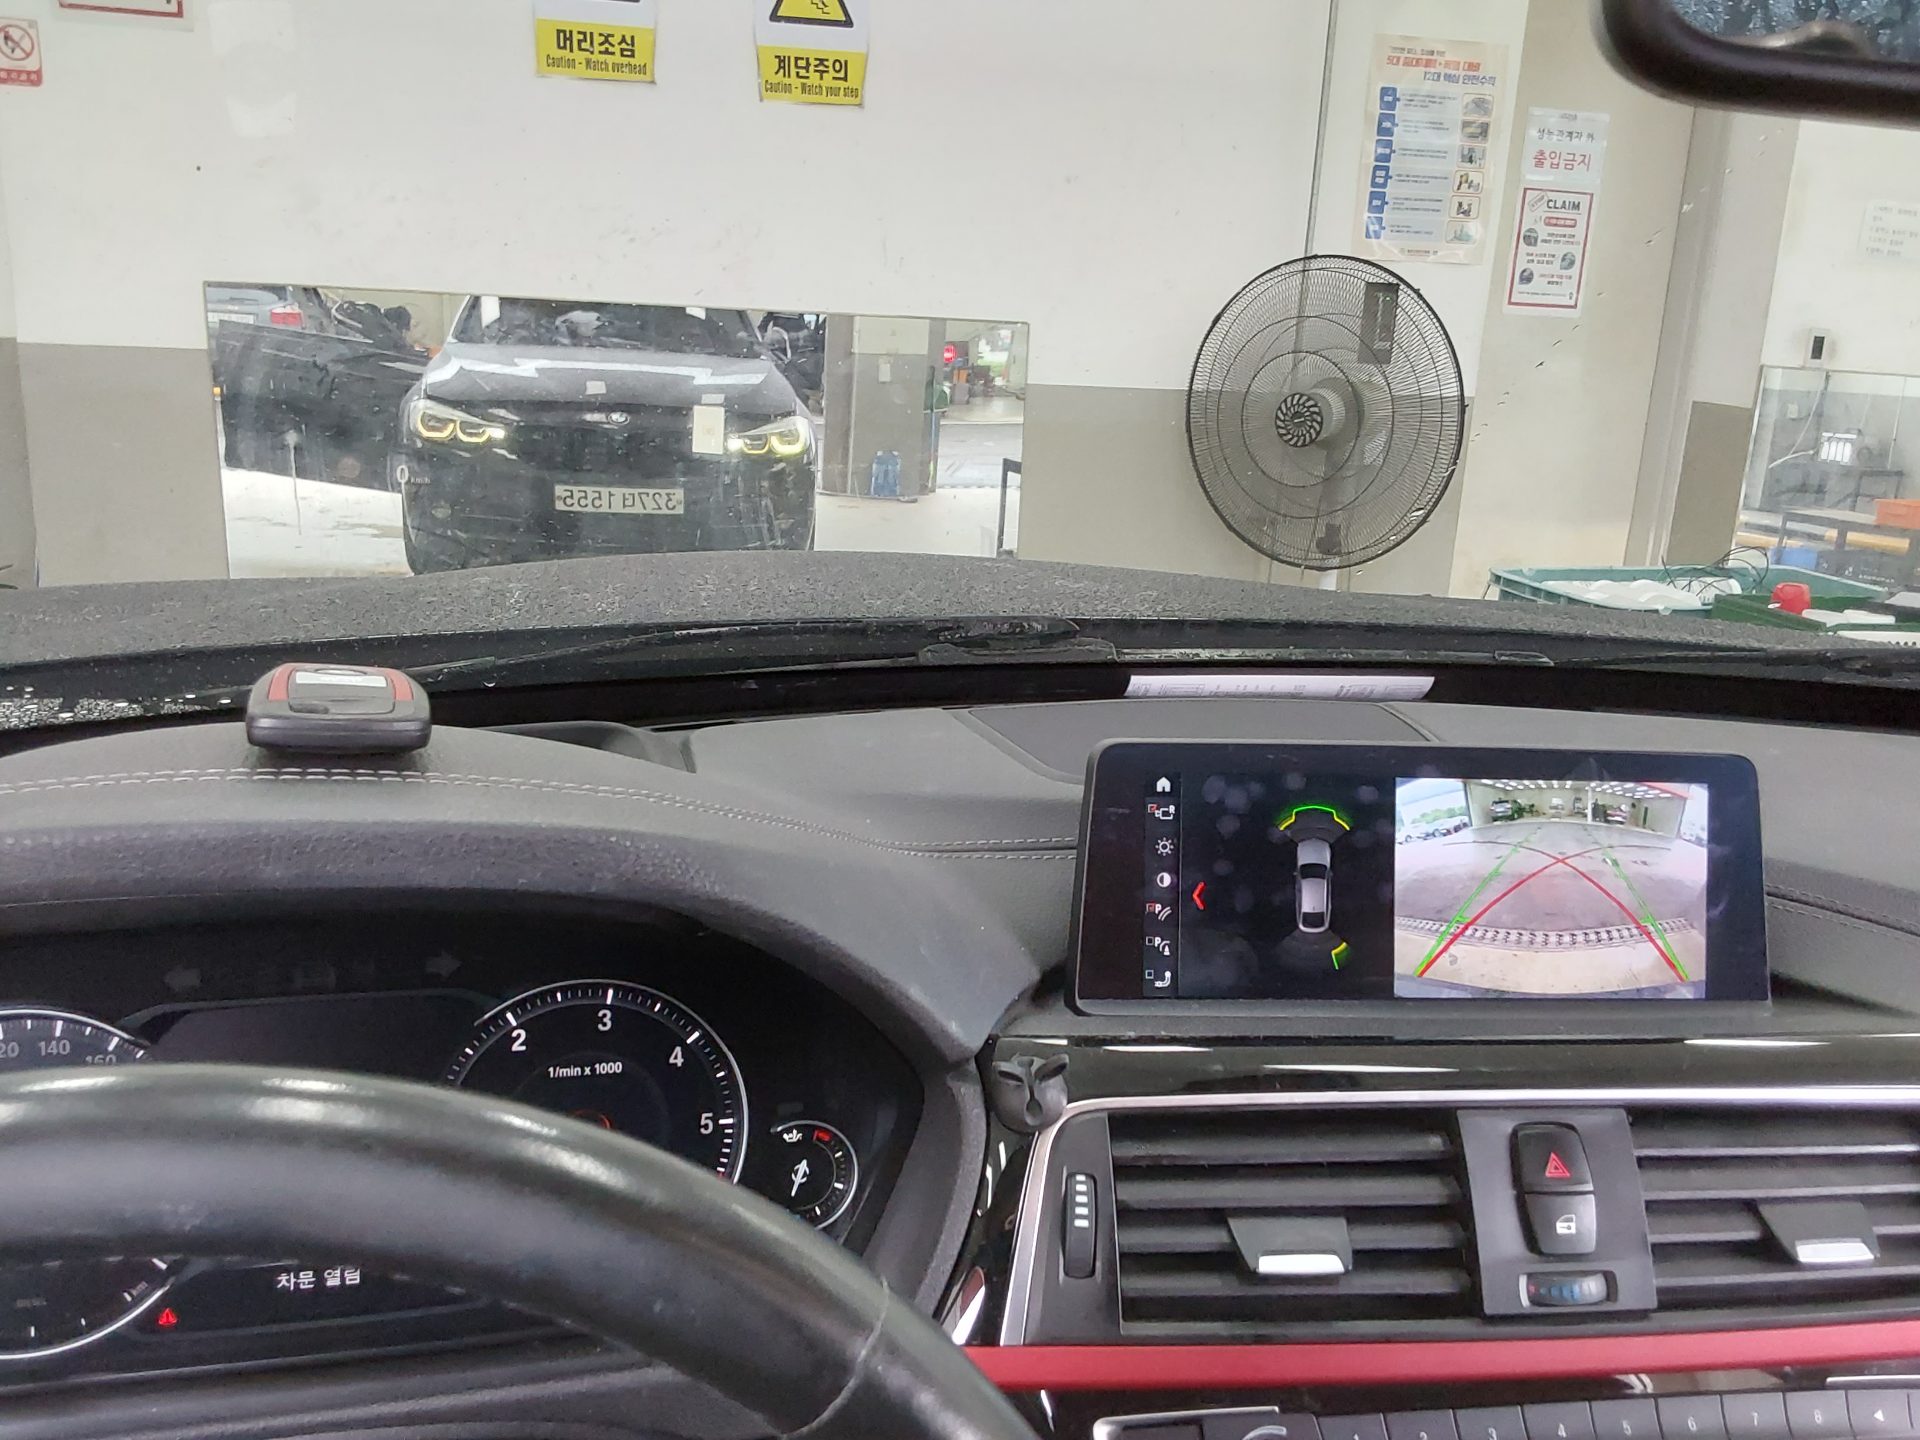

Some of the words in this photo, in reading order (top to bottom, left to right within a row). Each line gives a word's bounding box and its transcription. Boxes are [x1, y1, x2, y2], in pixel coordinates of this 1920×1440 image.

[556, 28, 635, 58] 머리조심
[546, 54, 576, 69] Caution
[585, 57, 609, 72] Watch
[611, 61, 647, 75] overhead
[774, 55, 848, 82] 계단주의
[765, 80, 792, 94] Caution
[801, 82, 823, 96] Watch
[825, 85, 841, 97] your
[843, 86, 859, 98] step
[1533, 149, 1591, 172] 출입금지
[1546, 199, 1581, 211] CLAIM
[597, 1010, 611, 1031] 3
[39, 1039, 71, 1056] 140
[511, 1029, 527, 1052] 2
[669, 1046, 684, 1067] 4
[548, 1064, 582, 1078] 1/min
[583, 1065, 591, 1076] x
[594, 1061, 623, 1075] 1000
[700, 1113, 714, 1134] 5
[277, 1270, 316, 1291] 차문
[1687, 1417, 1697, 1431] 6
[1751, 1412, 1760, 1427] 7
[1814, 1410, 1823, 1424] 8
[1557, 1423, 1567, 1438] 4
[1622, 1420, 1632, 1436] 5
